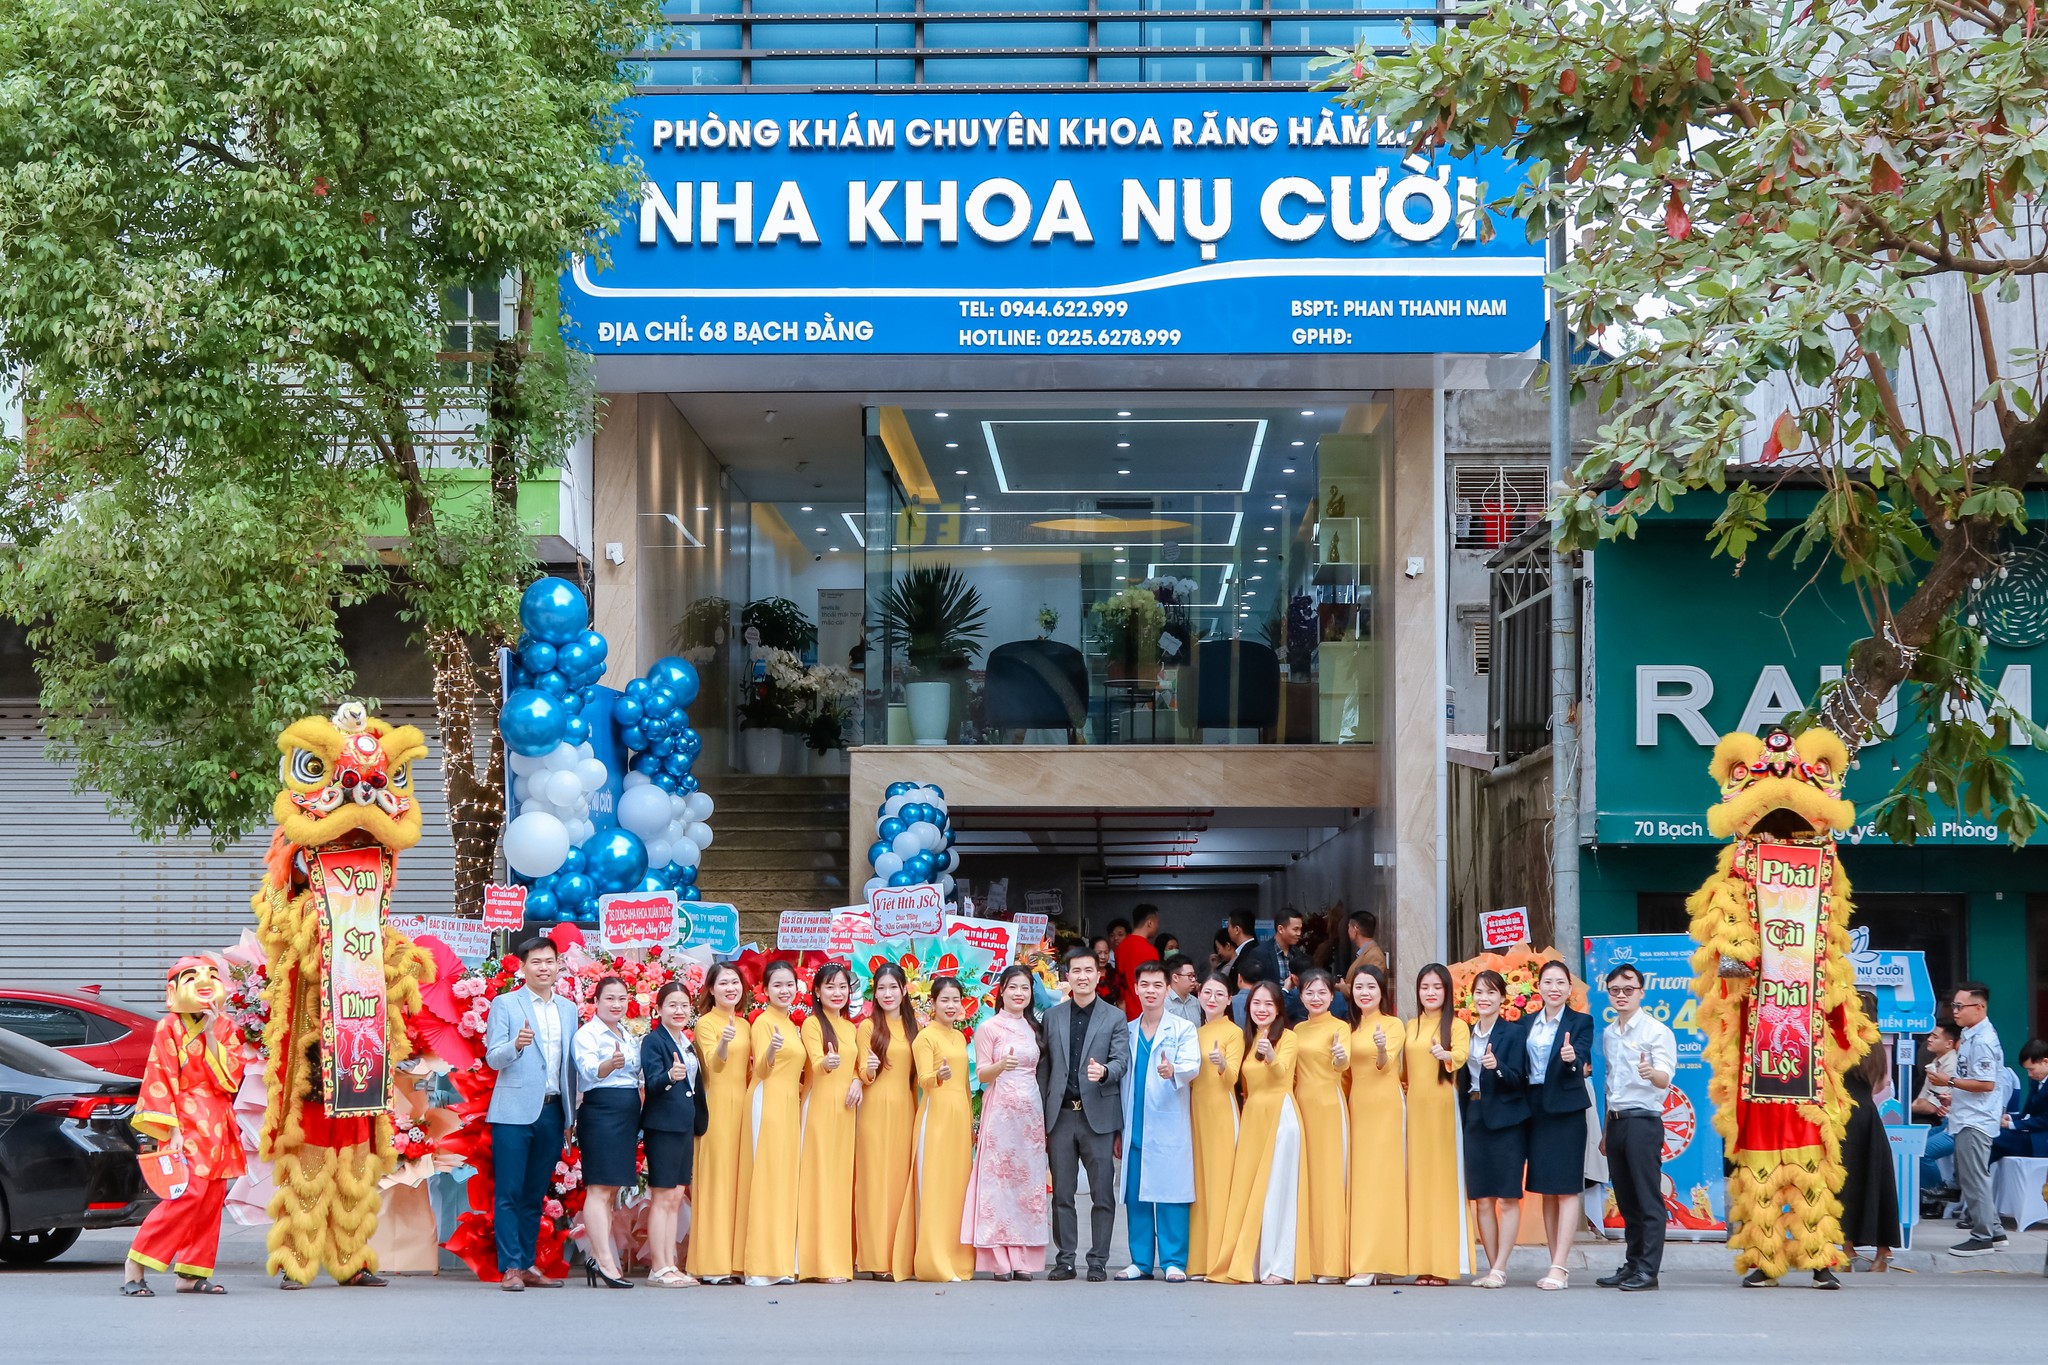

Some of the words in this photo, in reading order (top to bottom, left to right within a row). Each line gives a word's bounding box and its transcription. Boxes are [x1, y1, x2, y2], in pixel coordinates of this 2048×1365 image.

[653, 111, 780, 149] PHÒNG
[789, 111, 896, 149] KHÁM
[905, 111, 1050, 149] CHUYÊN
[1059, 117, 1163, 147] KHOA
[1174, 110, 1278, 147] RĂNG
[1288, 107, 1370, 147] HÀM
[639, 180, 821, 245] NHA
[847, 177, 1095, 245] KHOA
[1121, 177, 1233, 261] NỤ
[1260, 153, 1478, 243] CƯỜI
[959, 301, 995, 318] TEL:
[1000, 301, 1129, 318] 0944.622.999
[1291, 300, 1339, 317] BSPT:
[1343, 300, 1394, 317] PHAN
[1399, 300, 1461, 317] THANH
[1466, 299, 1507, 316] NAM
[598, 321, 640, 346] ĐỊA
[644, 315, 694, 342] CHỈ:
[699, 321, 728, 342] 68
[733, 321, 799, 346] BẠCH
[804, 311, 875, 342] ĐẰNG
[959, 329, 1041, 347] HOTLINE:
[1046, 329, 1182, 347] 0225.6278.999
[1292, 328, 1352, 345] GPHĐ:
[1634, 821, 1654, 836] 70
[1658, 821, 1703, 840] Bạch
[1942, 820, 1998, 841] Phòng
[333, 866, 377, 895] Vạn
[1761, 859, 1816, 888] Phát
[876, 896, 895, 912] Việt
[897, 896, 915, 909] Hth
[916, 894, 936, 909] JSC
[344, 927, 374, 961] Sự
[1765, 920, 1805, 950] Tài
[1857, 967, 1872, 978] NỤ
[1876, 965, 1904, 975] CƯỜI
[341, 992, 378, 1018] Như
[1761, 981, 1808, 1007] Phát
[1673, 999, 1700, 1035] 4
[1907, 1016, 1928, 1028] PHÍ
[1678, 1042, 1702, 1051] CƯỜI
[1760, 1049, 1801, 1081] Lộc
